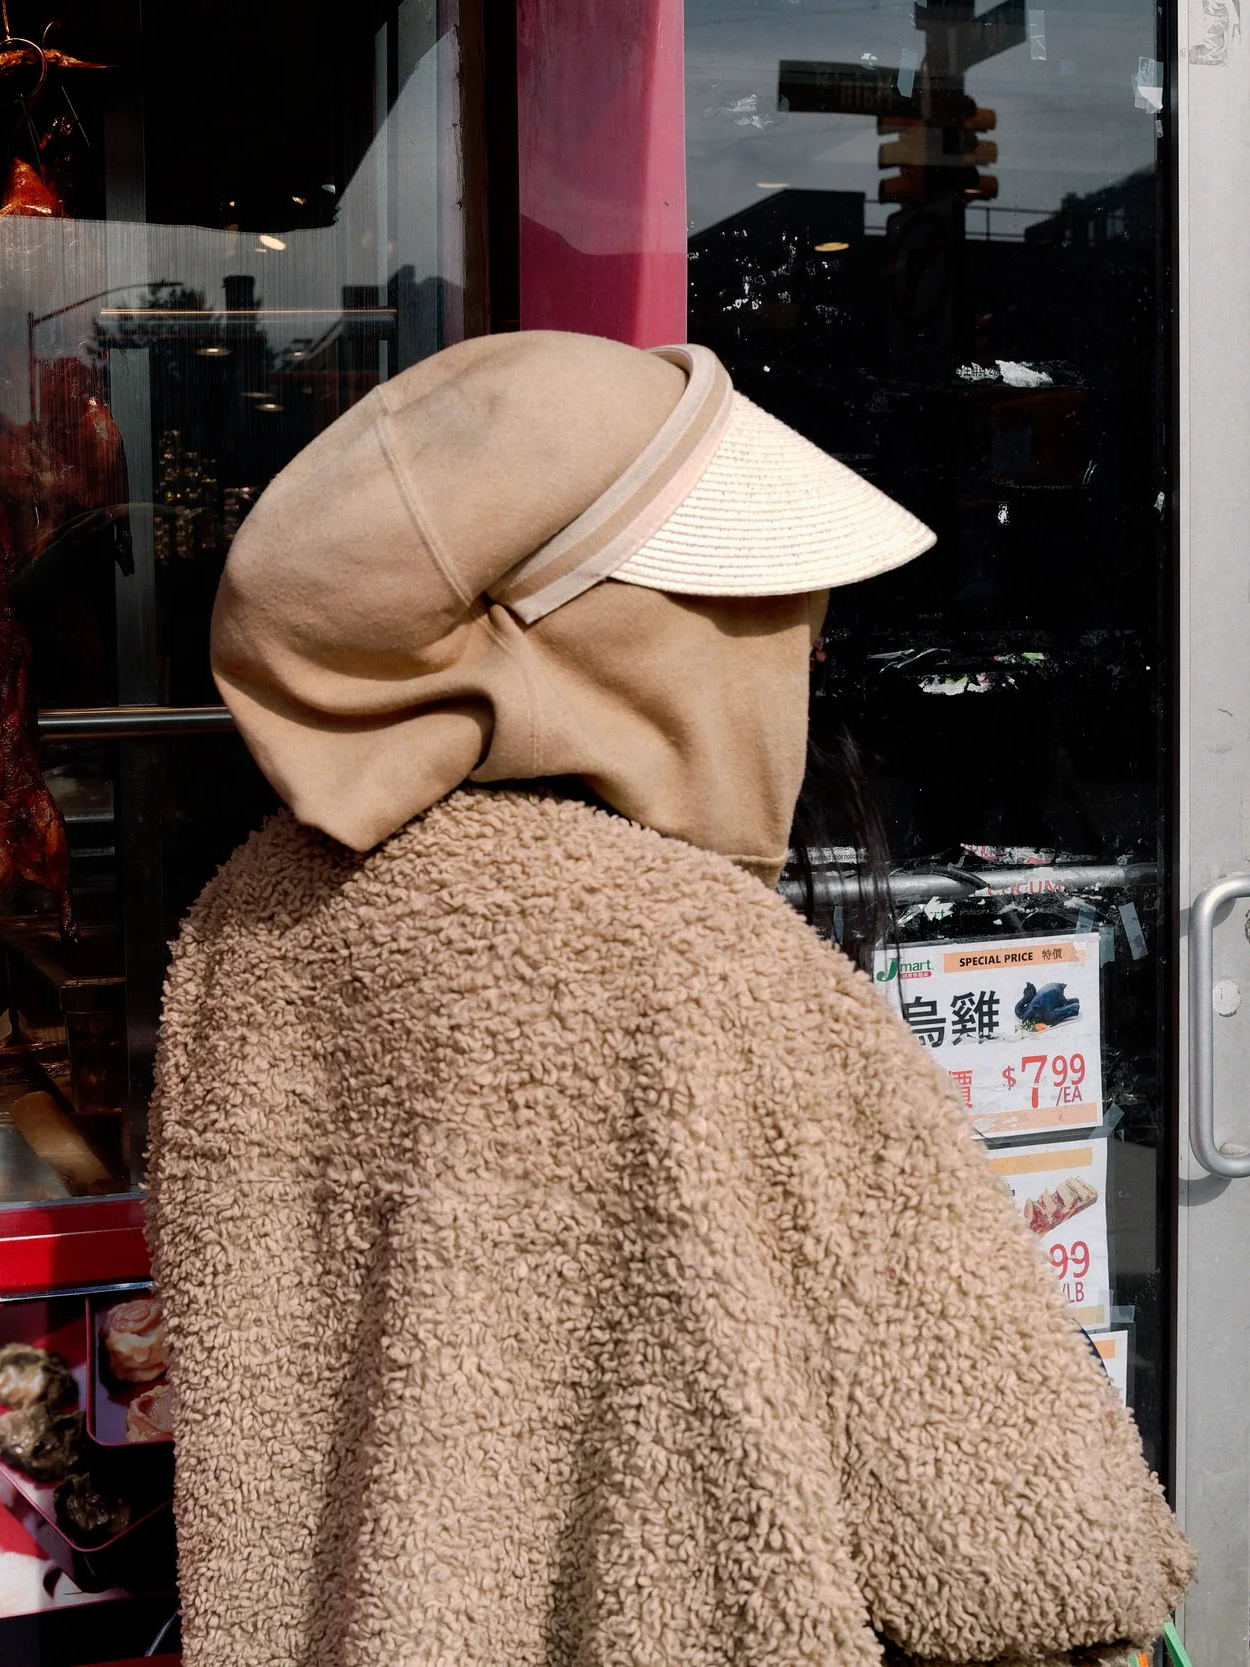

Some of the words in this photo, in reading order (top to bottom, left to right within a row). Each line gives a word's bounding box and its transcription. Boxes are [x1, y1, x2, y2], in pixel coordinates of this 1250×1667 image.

[959, 954, 1002, 967] SPECIAL
[1004, 952, 1034, 963] PRICE
[1041, 947, 1062, 960] 特價
[1055, 1086, 1083, 1107] /EA
